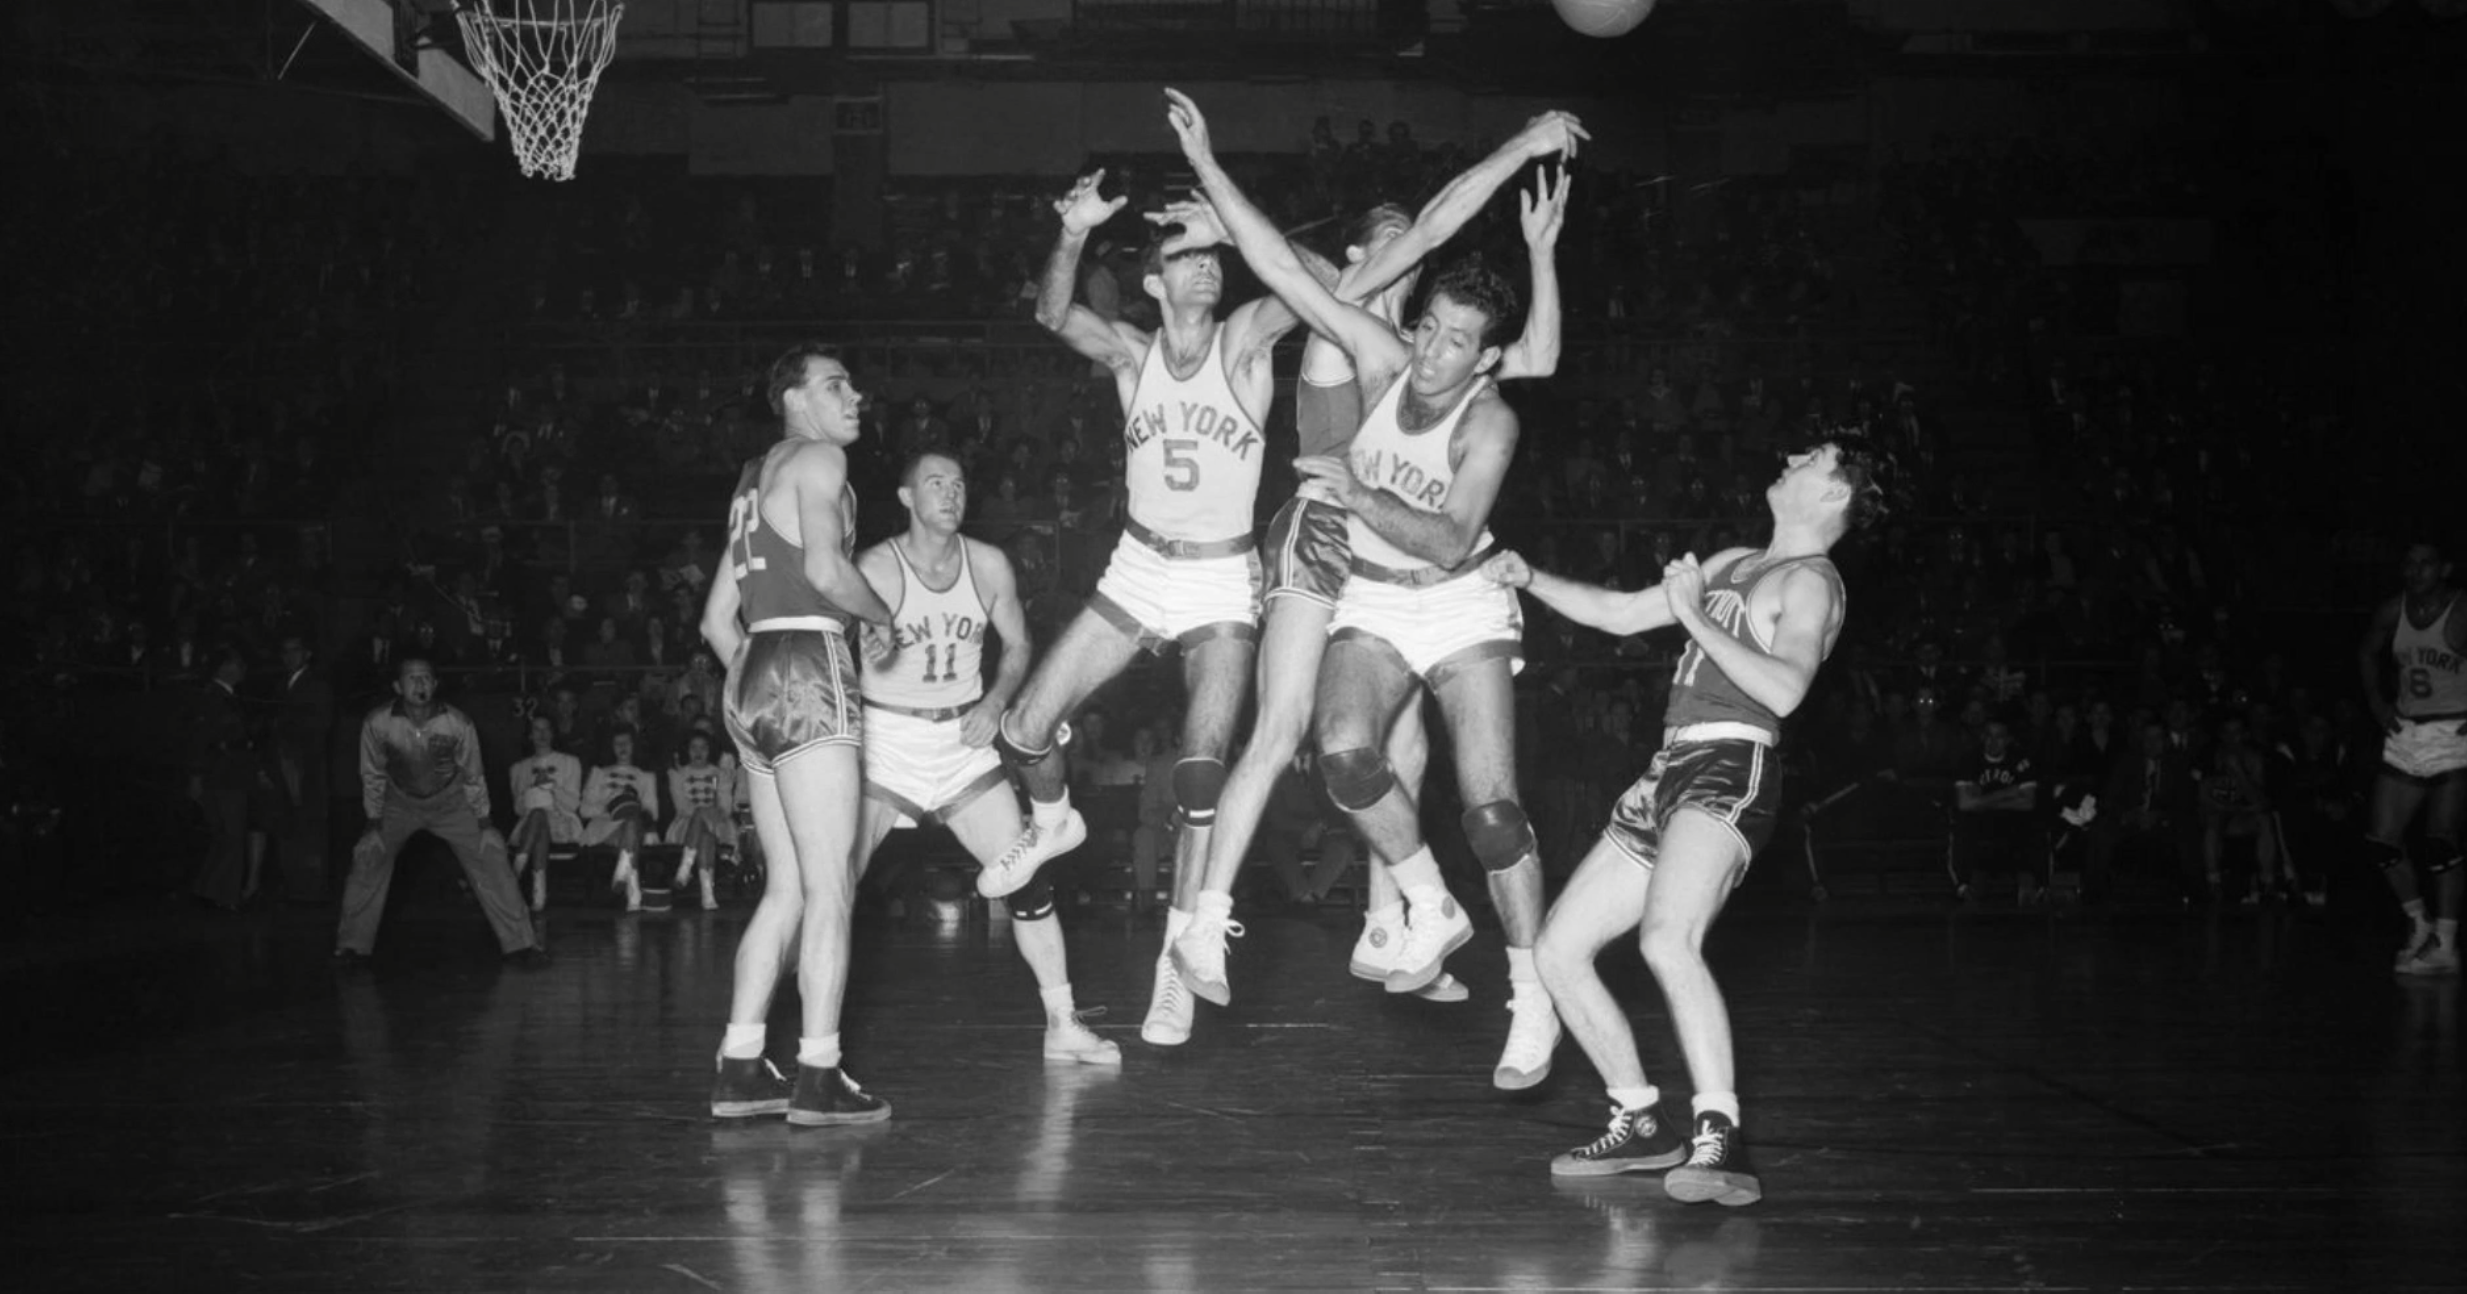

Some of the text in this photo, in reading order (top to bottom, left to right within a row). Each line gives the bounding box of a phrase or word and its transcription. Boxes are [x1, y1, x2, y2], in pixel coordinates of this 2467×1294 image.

[1125, 401, 1258, 461] NEW YORK
[1163, 438, 1200, 491] 5
[1391, 453, 1445, 510] YOR
[729, 487, 766, 579] 22
[895, 616, 932, 649] EW
[922, 644, 958, 682] 11
[2417, 647, 2465, 675] YORK
